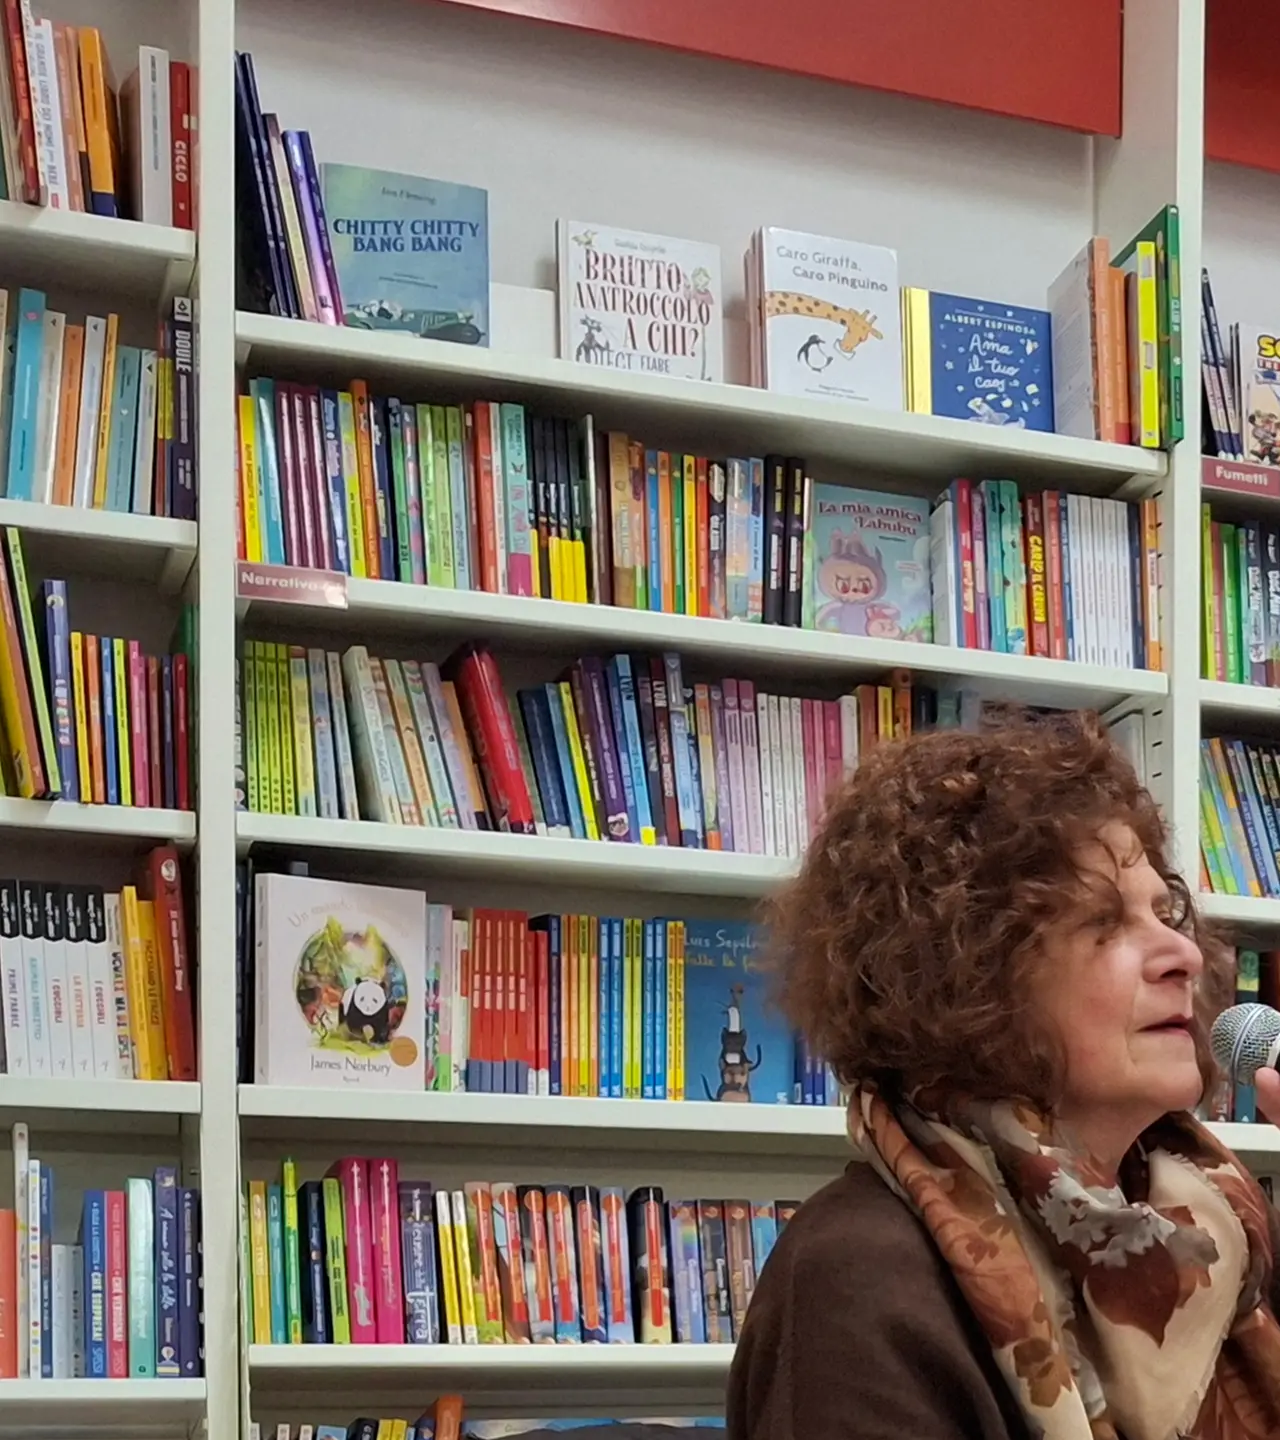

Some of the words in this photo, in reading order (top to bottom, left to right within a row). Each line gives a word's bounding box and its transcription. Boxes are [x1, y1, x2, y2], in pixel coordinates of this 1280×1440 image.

[333, 219, 404, 235] CHITTY
[410, 220, 480, 237] CHITTY
[353, 236, 405, 252] BANG
[411, 237, 462, 253] BANG
[776, 246, 808, 262] Caro
[585, 249, 681, 292] BRUTTO
[792, 266, 824, 283] Caro
[828, 272, 888, 293] Pinguino
[574, 282, 710, 326] ANATROCCOLO
[944, 313, 981, 327] ALBERT
[985, 319, 1036, 335] ESPINOSA
[623, 318, 637, 350] A
[648, 321, 699, 357] CHI?
[969, 334, 1014, 356] Ama
[1215, 466, 1268, 486] Fumetti
[819, 501, 837, 514] La
[841, 504, 871, 516] mia
[876, 508, 922, 523] amica
[855, 516, 917, 536] Labubu
[241, 571, 318, 592] Narrativa
[310, 1055, 343, 1073] James
[345, 1057, 391, 1076] Norbury
